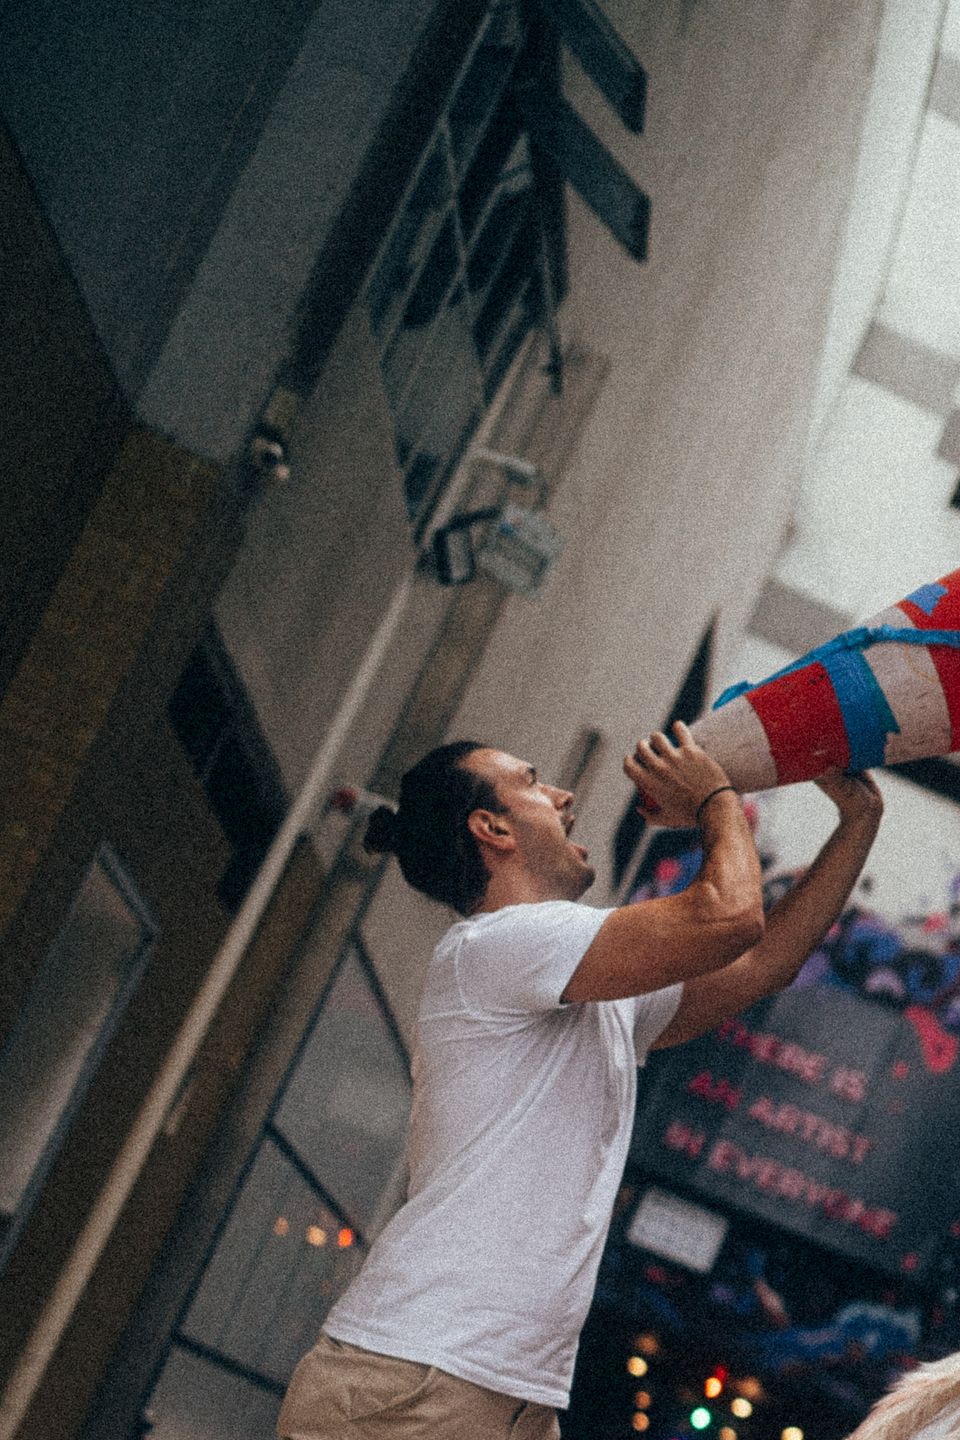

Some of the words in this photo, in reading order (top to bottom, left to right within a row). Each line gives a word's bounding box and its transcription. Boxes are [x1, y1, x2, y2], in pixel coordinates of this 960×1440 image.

[688, 1071, 742, 1109] AN
[748, 1096, 871, 1164] ARTIST
[832, 1069, 865, 1101] IS
[665, 1123, 704, 1156] IN
[710, 1143, 897, 1238] EVERYONE
